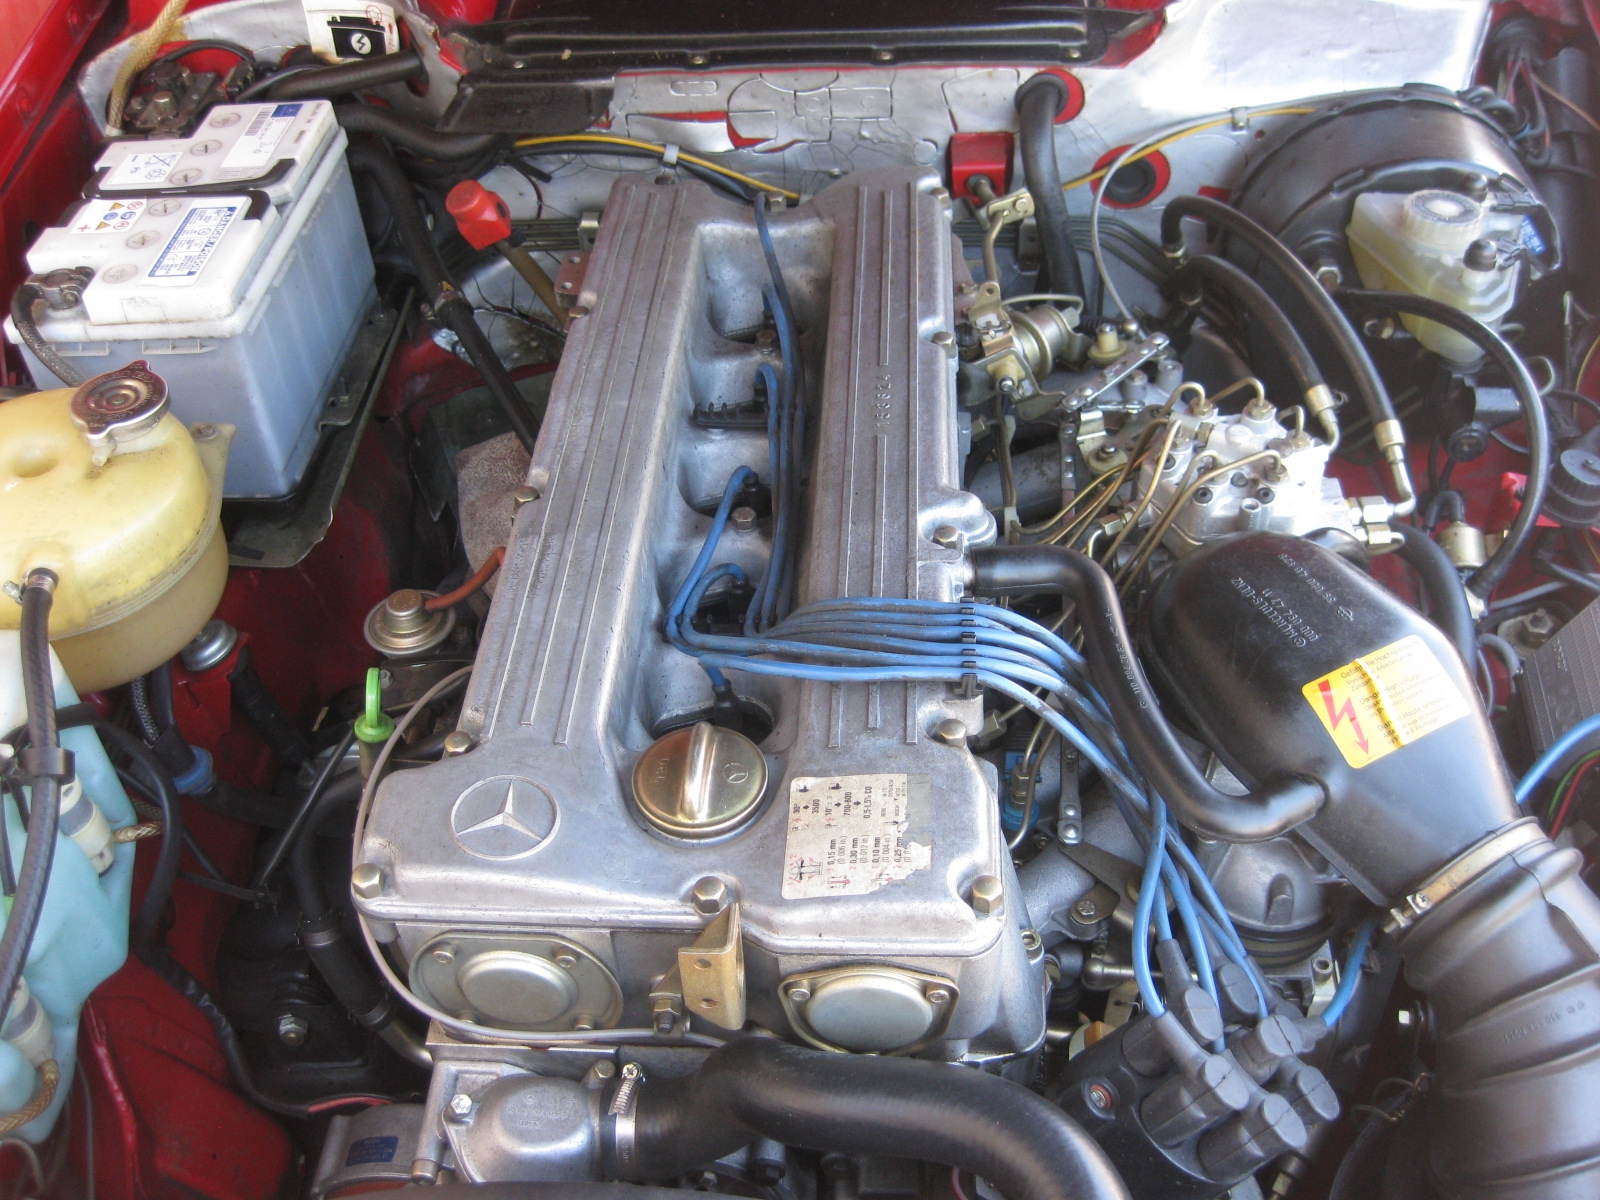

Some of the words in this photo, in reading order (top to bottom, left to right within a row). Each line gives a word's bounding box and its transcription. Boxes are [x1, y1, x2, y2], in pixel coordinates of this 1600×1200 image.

[812, 799, 820, 814] 3500
[830, 839, 836, 849] mm
[852, 838, 858, 848] mm
[874, 837, 880, 847] mm
[827, 852, 836, 865] 0,15
[849, 850, 858, 864] 0,30
[872, 850, 880, 863] 0,10
[894, 849, 902, 862] 0,25
